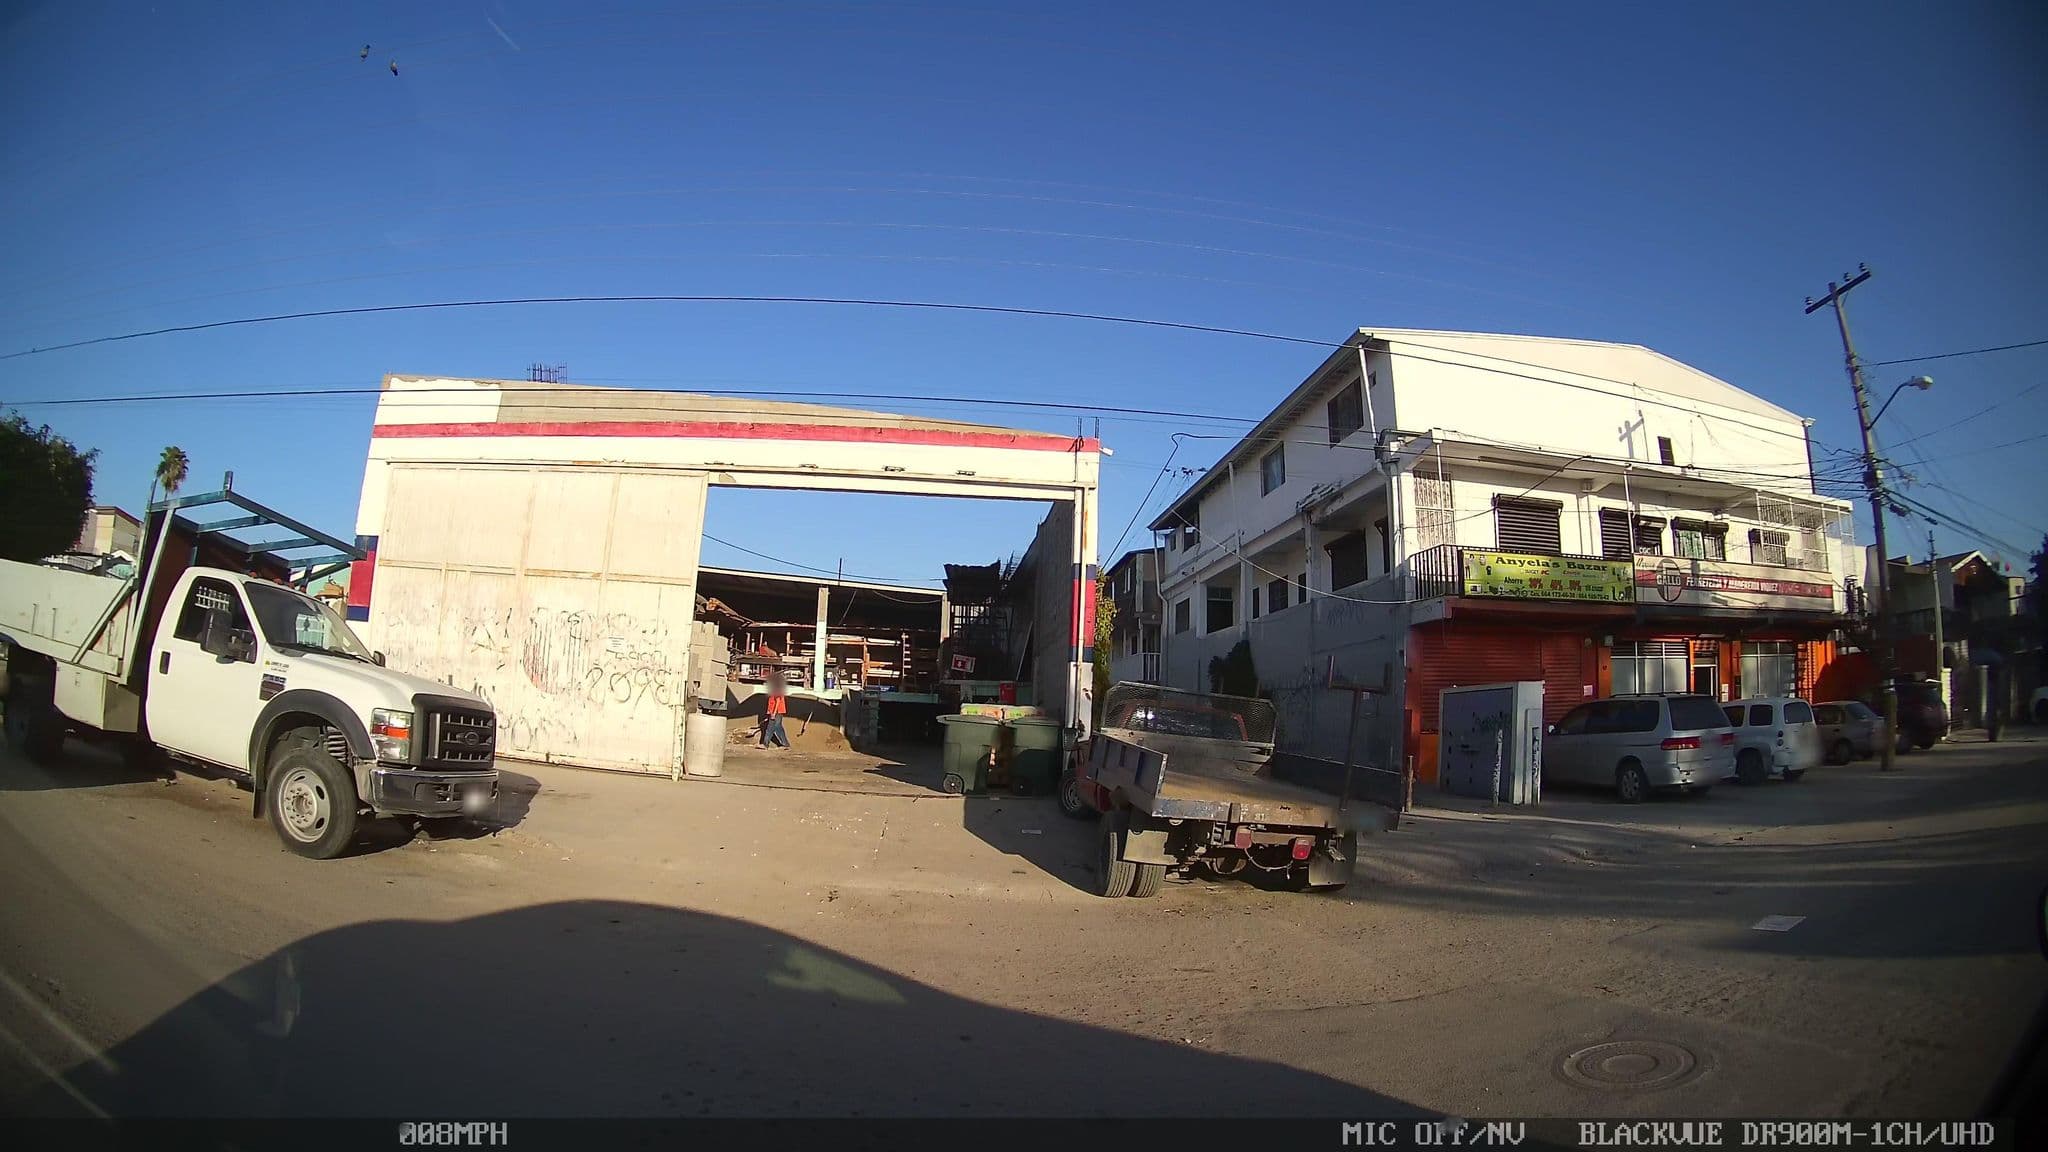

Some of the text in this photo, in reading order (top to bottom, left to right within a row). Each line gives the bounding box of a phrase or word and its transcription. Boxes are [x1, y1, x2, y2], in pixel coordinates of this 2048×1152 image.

[1496, 557, 1608, 571] Anyela's Bazar
[1657, 574, 1681, 586] GALLO
